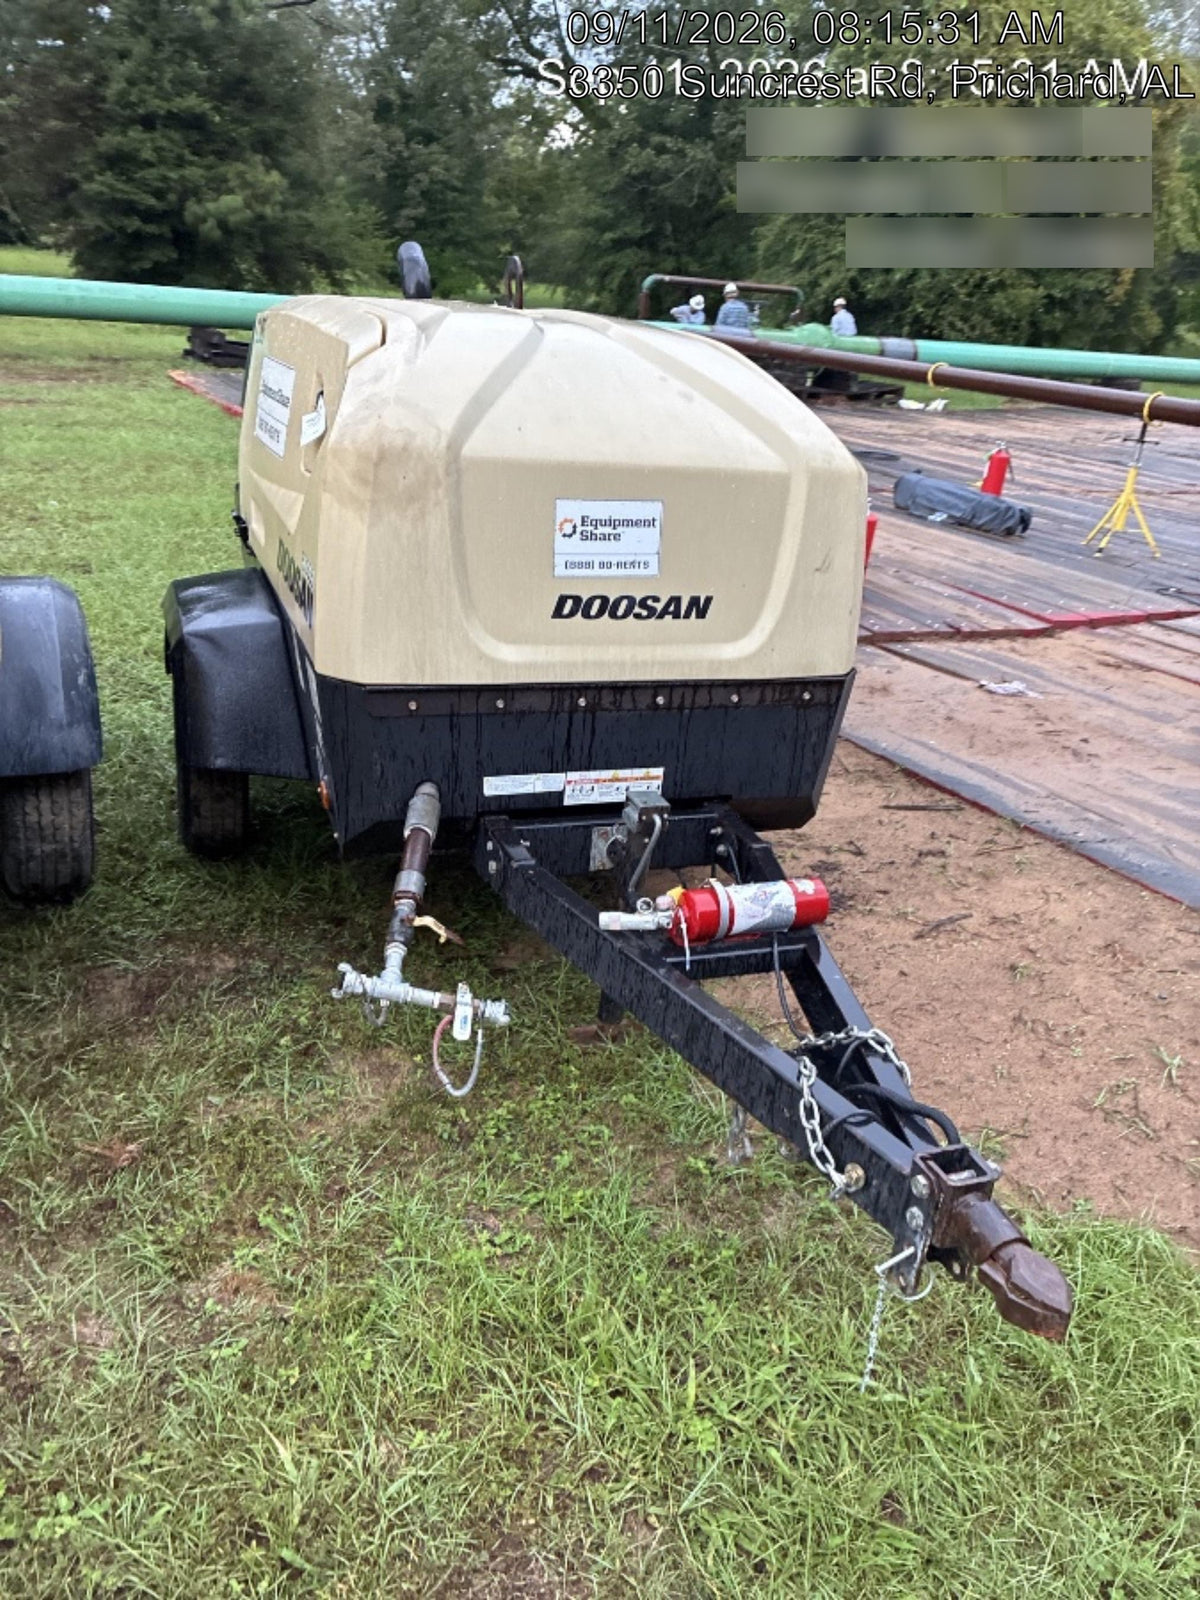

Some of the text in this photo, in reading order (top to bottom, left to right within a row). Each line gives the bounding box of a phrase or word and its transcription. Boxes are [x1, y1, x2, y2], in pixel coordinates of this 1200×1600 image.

[580, 515, 657, 530] Equipment
[579, 530, 622, 541] Share
[551, 593, 714, 620] DOOSAN
